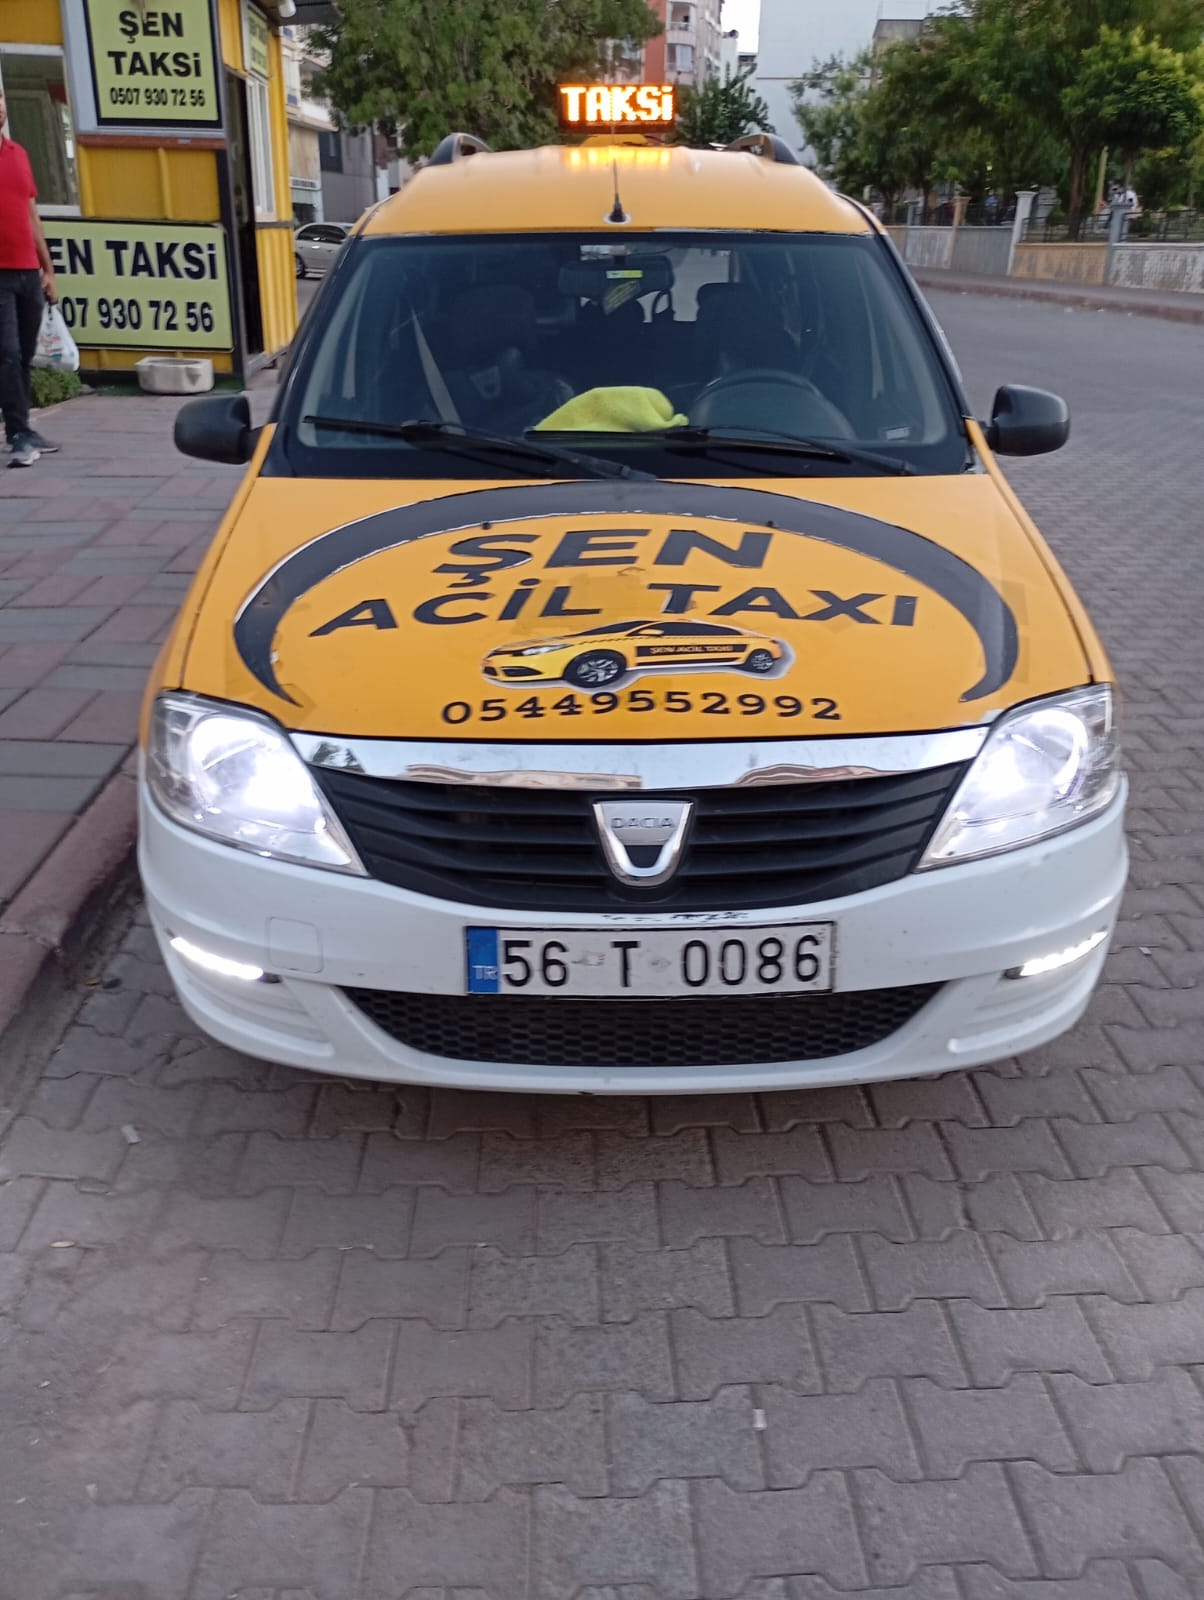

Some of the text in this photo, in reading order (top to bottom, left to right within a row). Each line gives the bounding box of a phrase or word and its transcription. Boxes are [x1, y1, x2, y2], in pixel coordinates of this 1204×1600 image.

[119, 10, 184, 44] ŞEN
[110, 87, 206, 107] 0507 930 72 56
[98, 297, 142, 330] 930
[148, 300, 179, 331] 72
[186, 301, 214, 332] 56
[432, 529, 774, 588] ŞEN
[647, 583, 918, 626] TAXI
[441, 690, 841, 725] 05449552992
[611, 817, 675, 829] DACIA
[472, 965, 498, 980] TR
[502, 934, 821, 988] 56 T 0086
